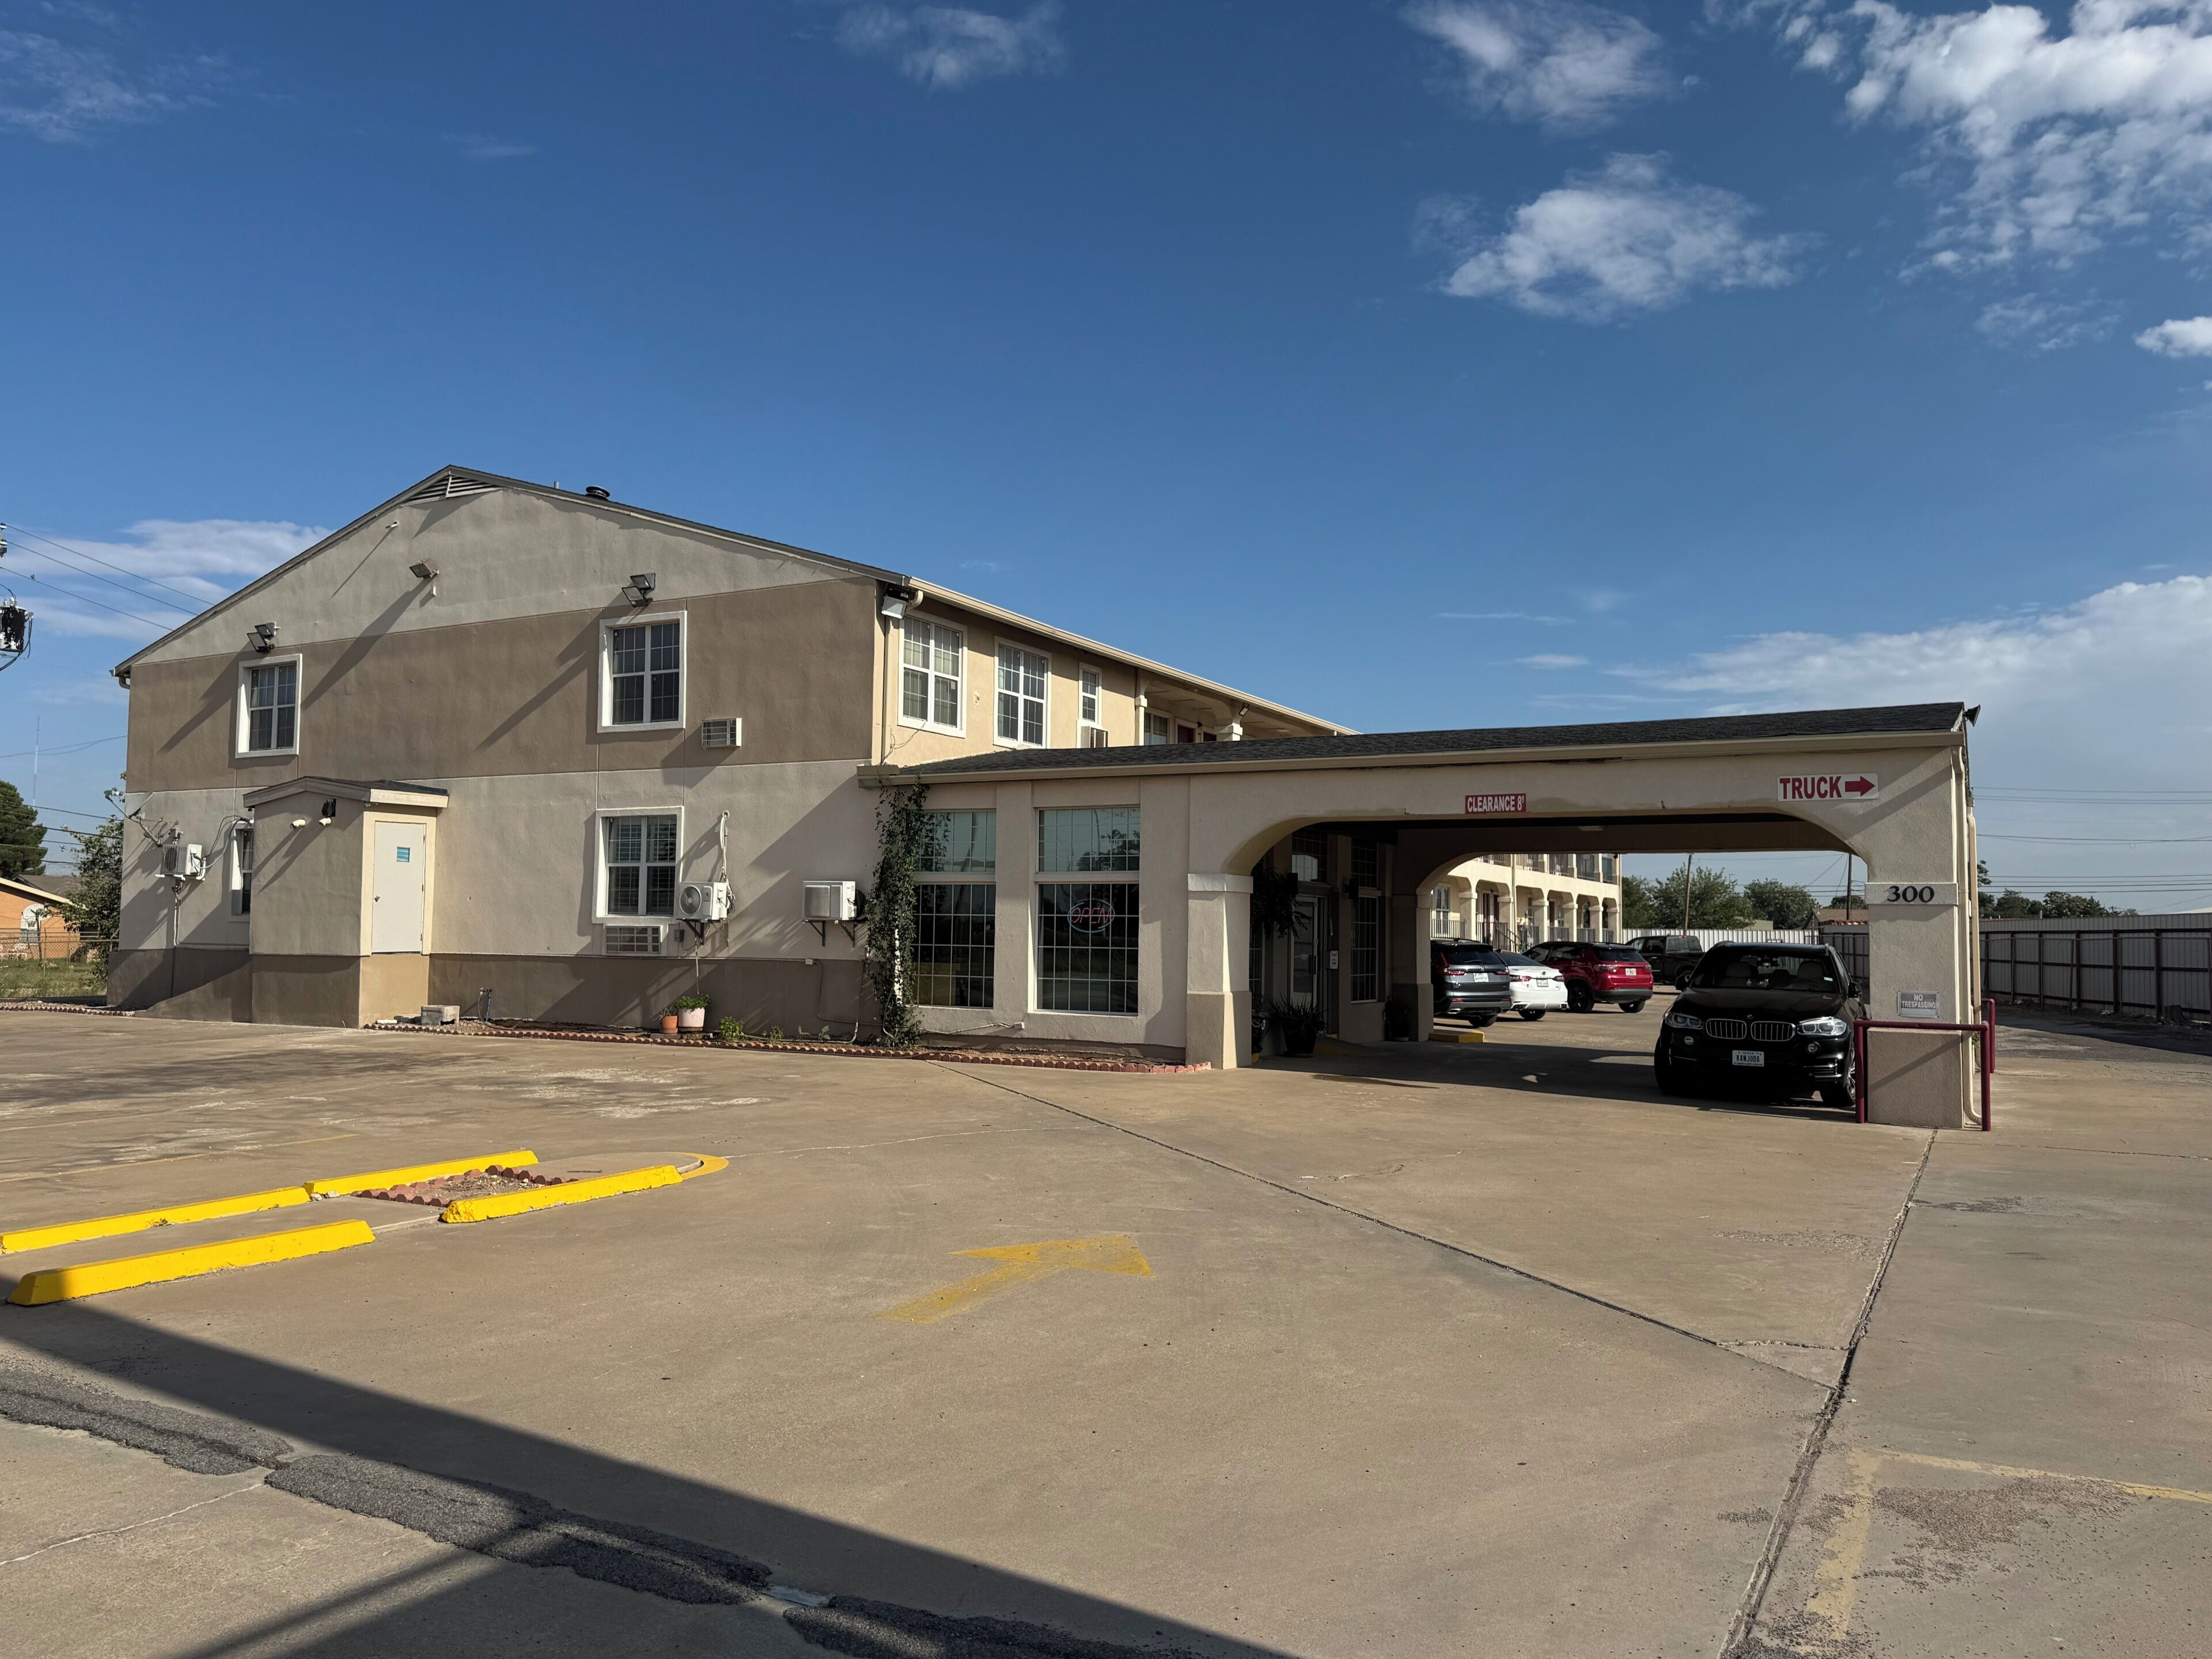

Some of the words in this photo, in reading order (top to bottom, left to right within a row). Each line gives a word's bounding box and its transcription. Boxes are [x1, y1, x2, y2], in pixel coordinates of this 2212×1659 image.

[1779, 776, 1842, 800] TRUCK
[1467, 796, 1515, 812] CLEARANCE
[1517, 795, 1524, 811] 8'
[1887, 885, 1934, 903] 300
[1072, 907, 1112, 924] OPEN
[1902, 1001, 1936, 1009] TRESPASSING
